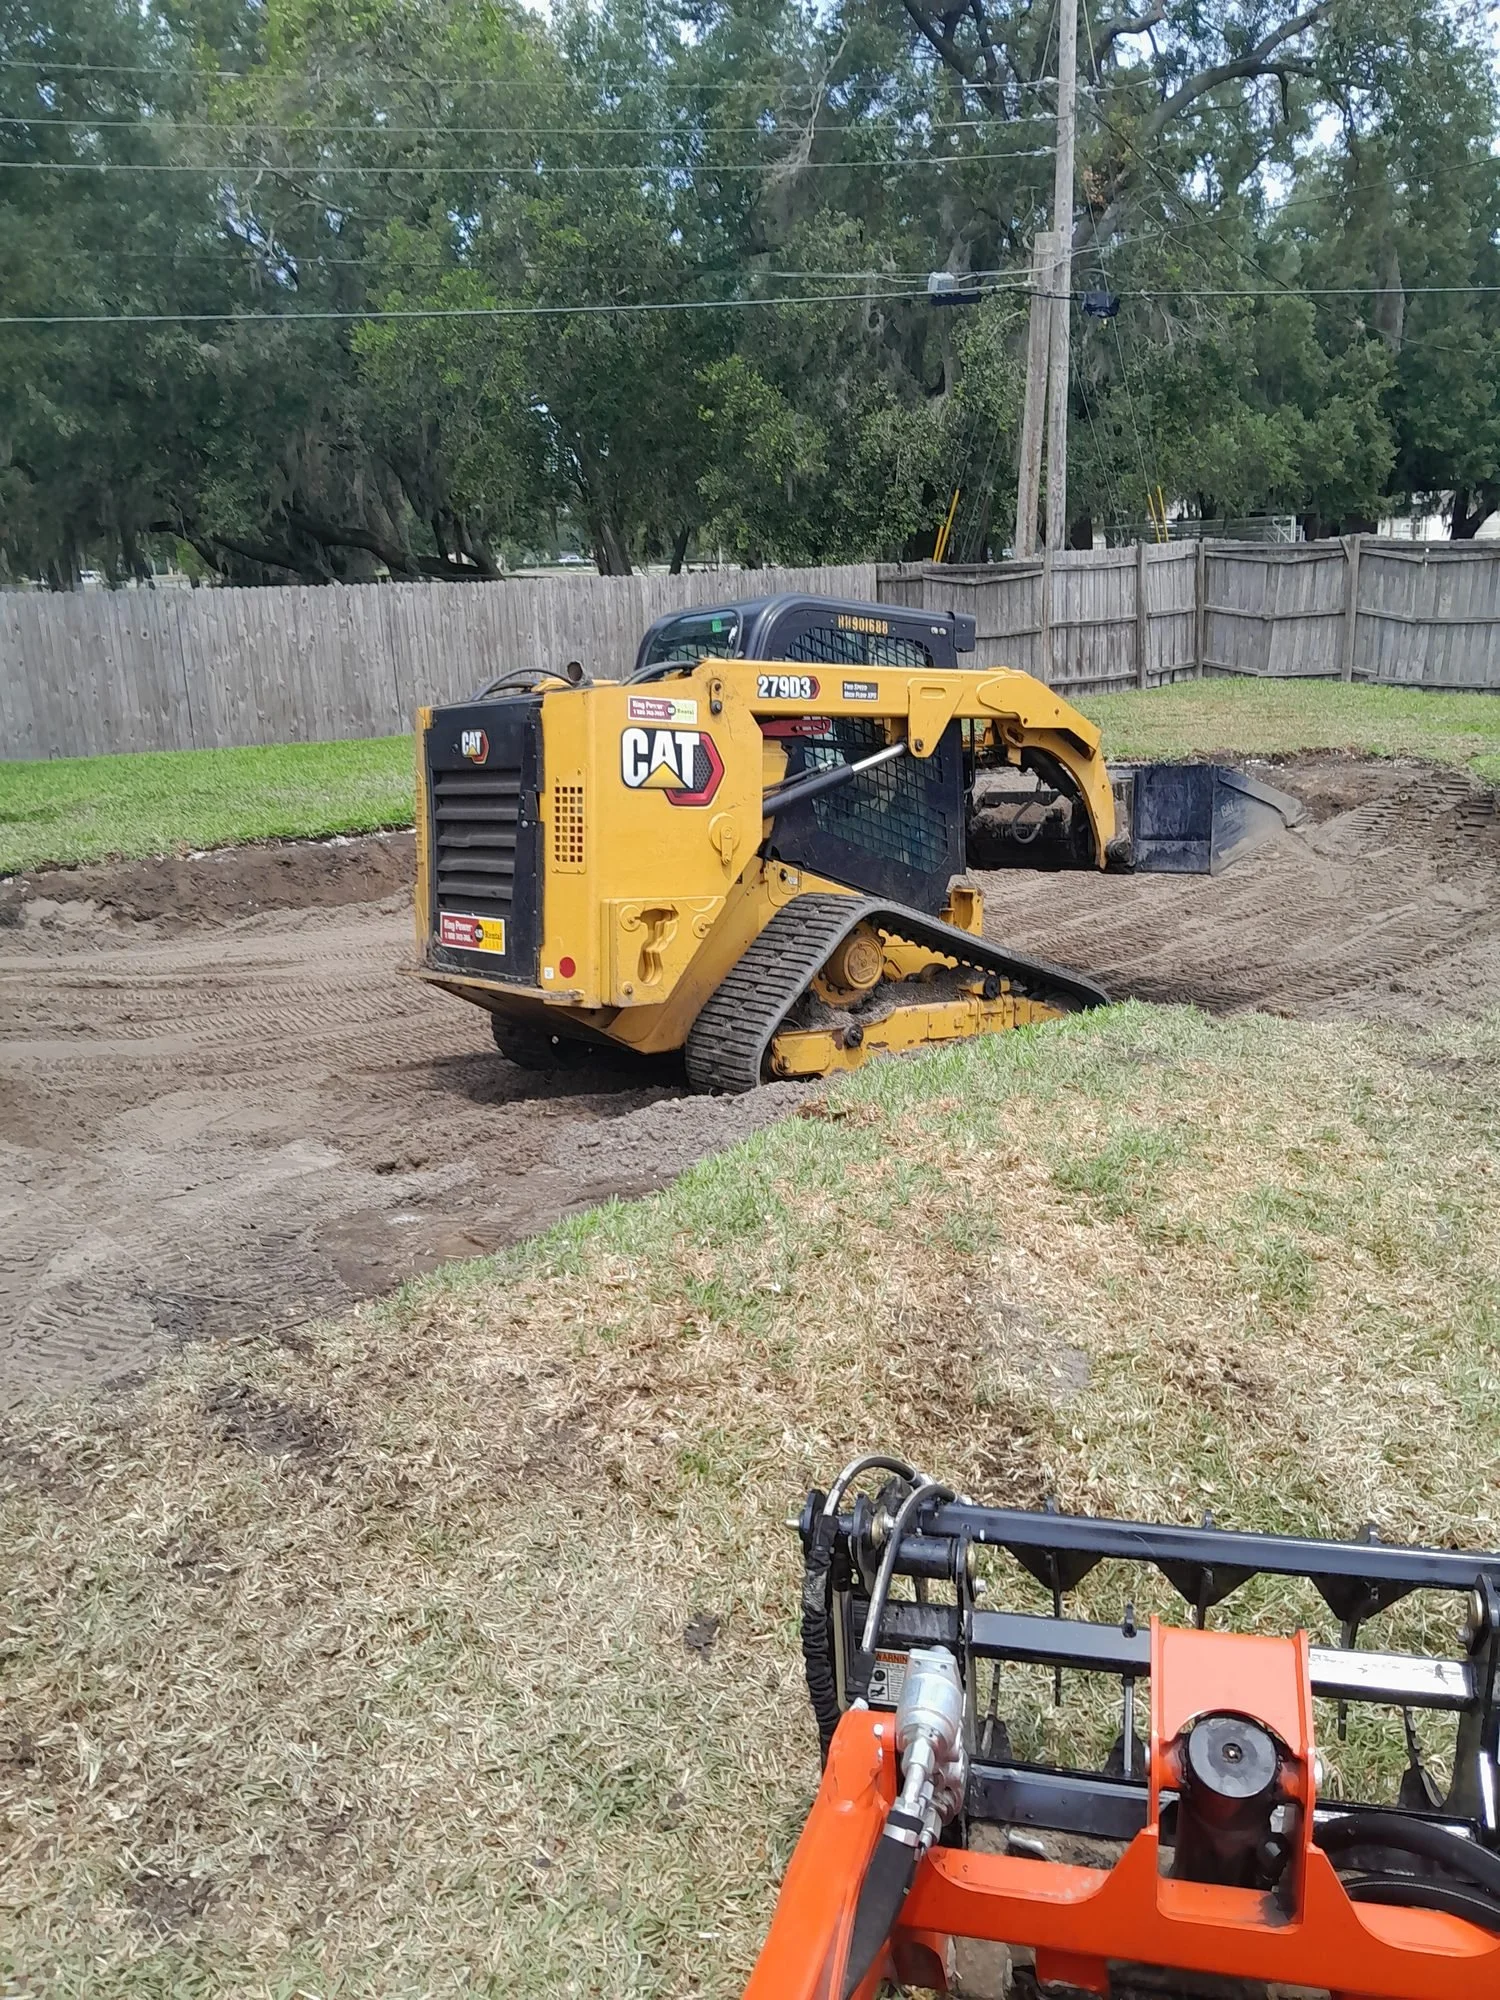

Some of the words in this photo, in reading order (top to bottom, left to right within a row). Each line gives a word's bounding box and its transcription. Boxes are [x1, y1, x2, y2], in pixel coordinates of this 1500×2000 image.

[757, 675, 811, 698] 279D3
[462, 731, 482, 756] CAT
[622, 728, 700, 788] CAT
[875, 1651, 908, 1665] WARNIN
